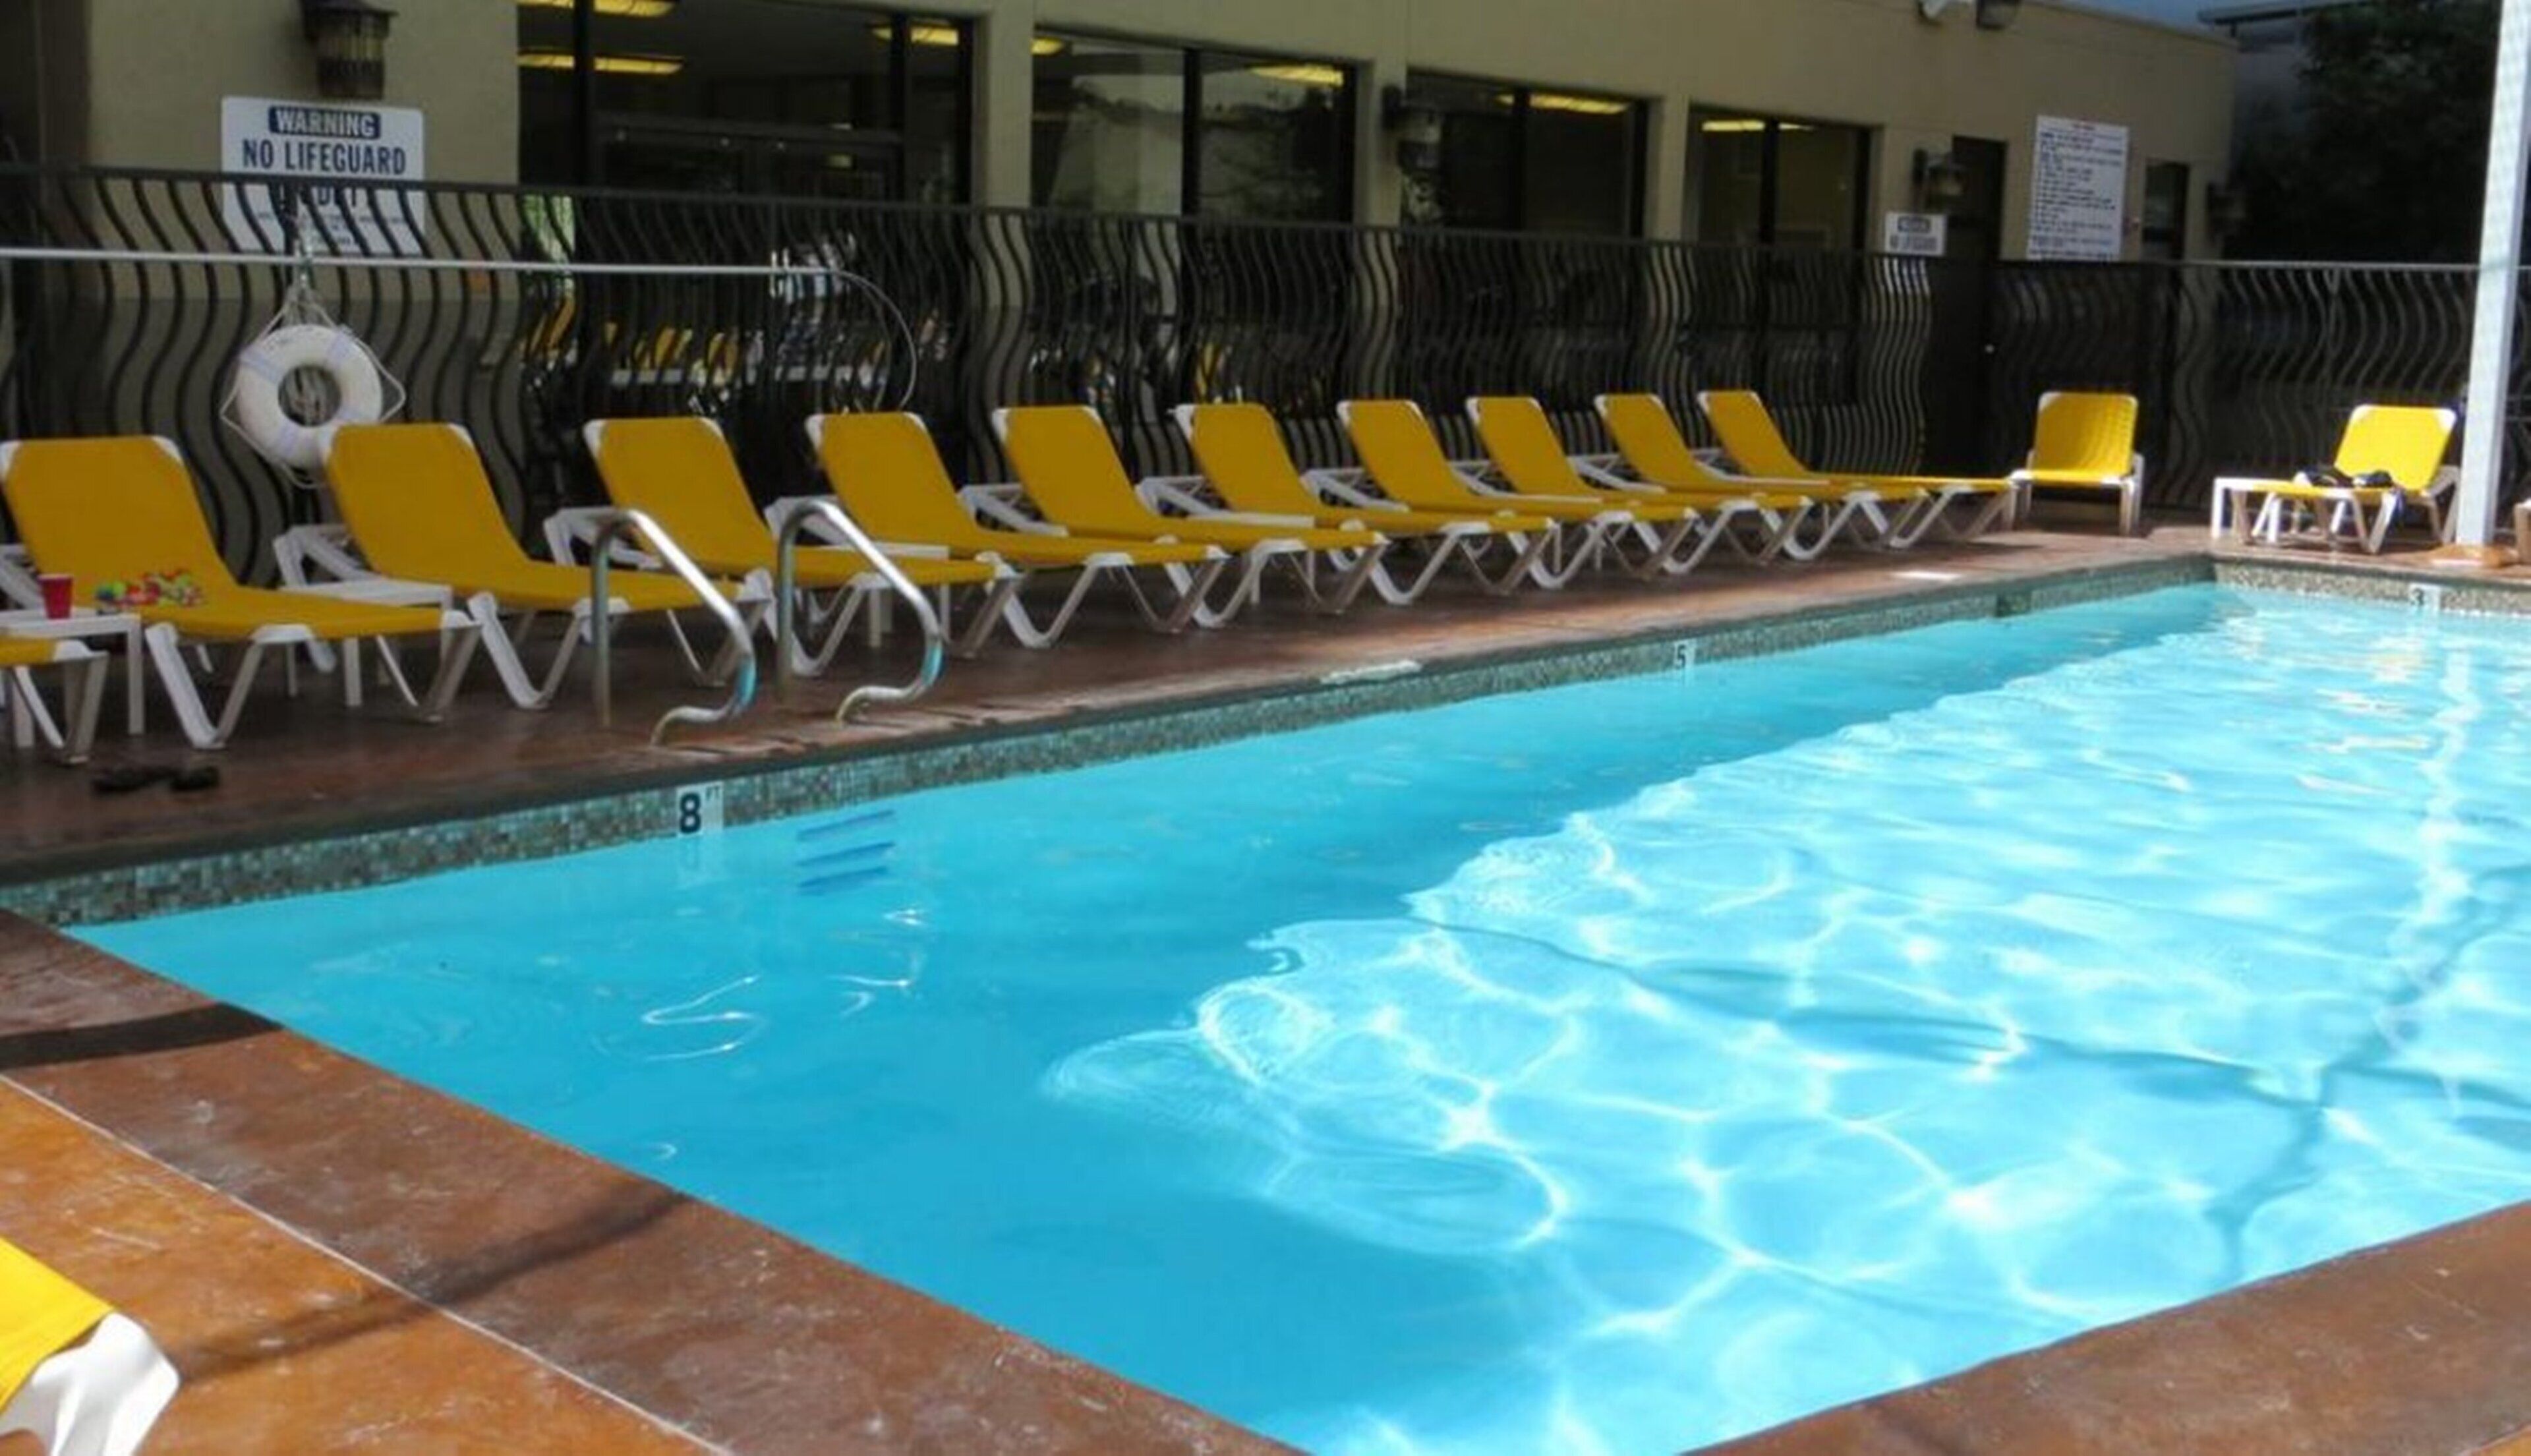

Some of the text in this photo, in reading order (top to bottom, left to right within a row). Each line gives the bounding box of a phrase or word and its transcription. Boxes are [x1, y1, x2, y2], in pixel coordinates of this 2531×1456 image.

[275, 107, 376, 137] WARNING
[242, 139, 406, 175] NO LIFEGUARD
[2411, 588, 2424, 606] 3
[1677, 645, 1686, 670] 5
[680, 793, 701, 834] 8
